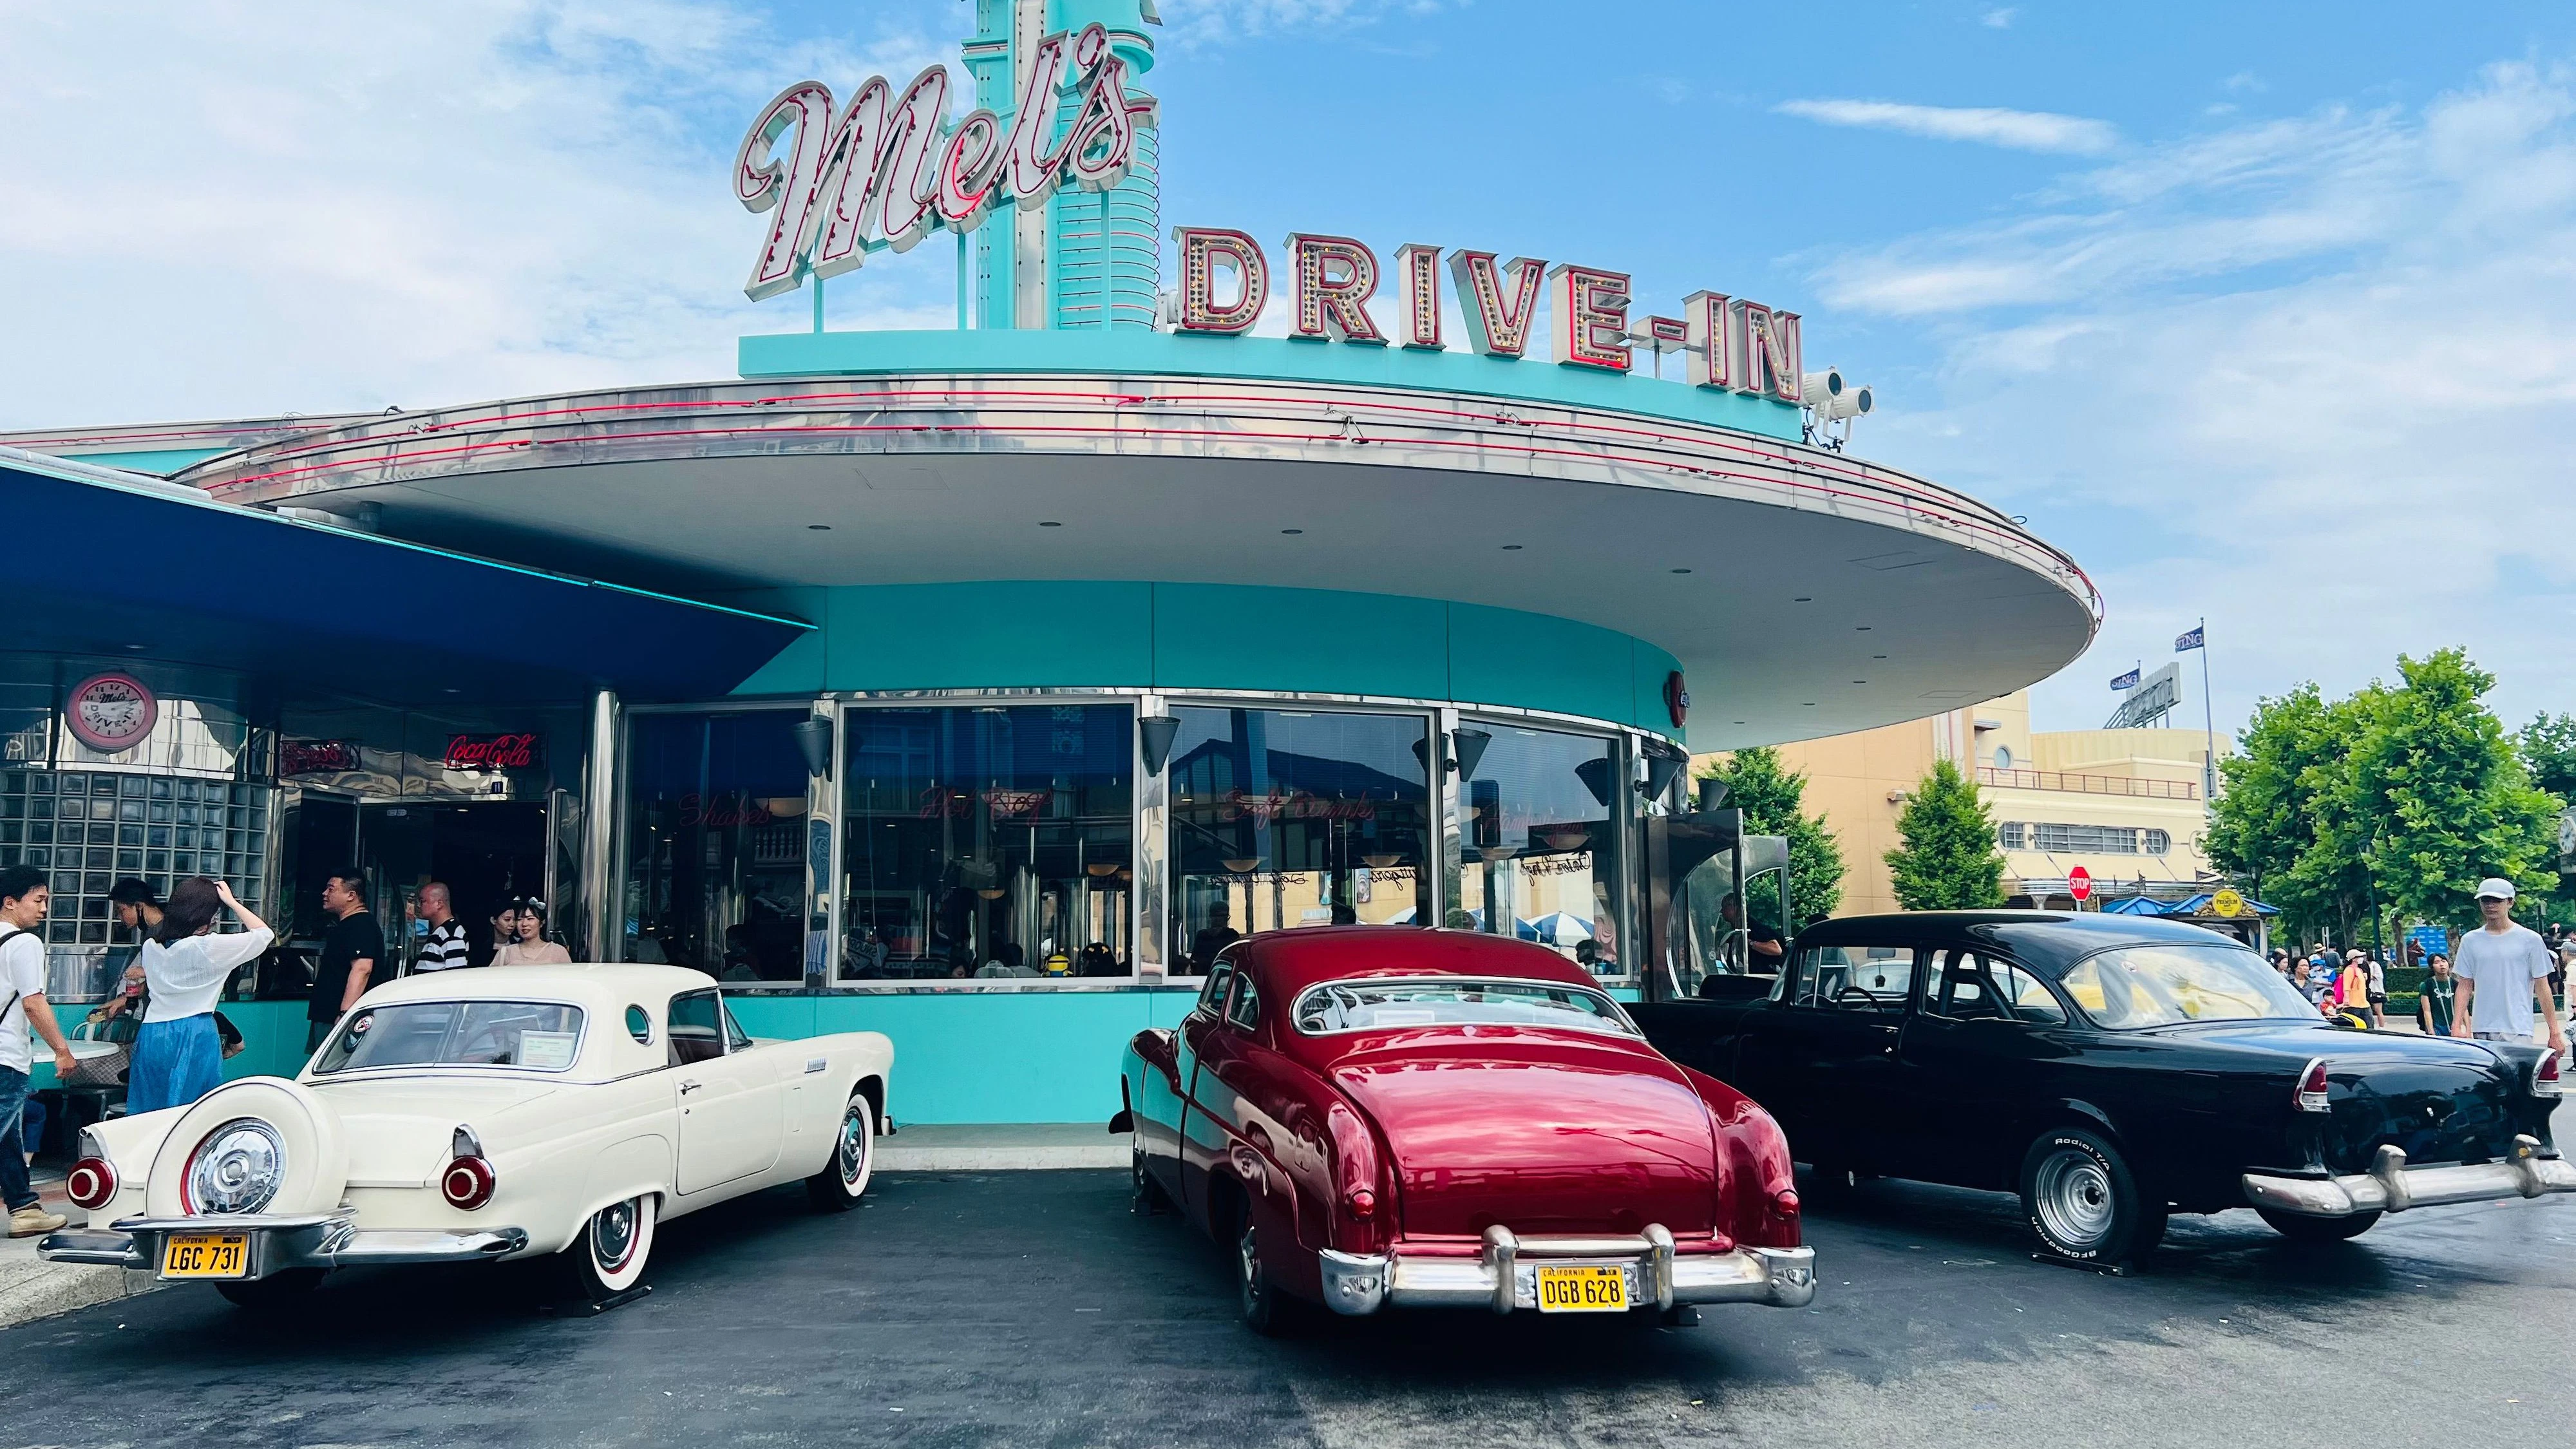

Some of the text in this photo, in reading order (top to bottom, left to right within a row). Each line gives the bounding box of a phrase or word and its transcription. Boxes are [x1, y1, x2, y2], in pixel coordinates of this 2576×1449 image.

[732, 21, 1158, 302] Mel's
[1173, 226, 1803, 408] DRIVE-IN
[678, 793, 770, 826] Shakes
[2070, 876, 2090, 890] STOP
[2055, 1138, 2110, 1171] Radial T/A
[2031, 1217, 2097, 1258] BFGoodrich
[169, 1247, 240, 1270] LGC 731
[1545, 1280, 1620, 1304] DGB 628
